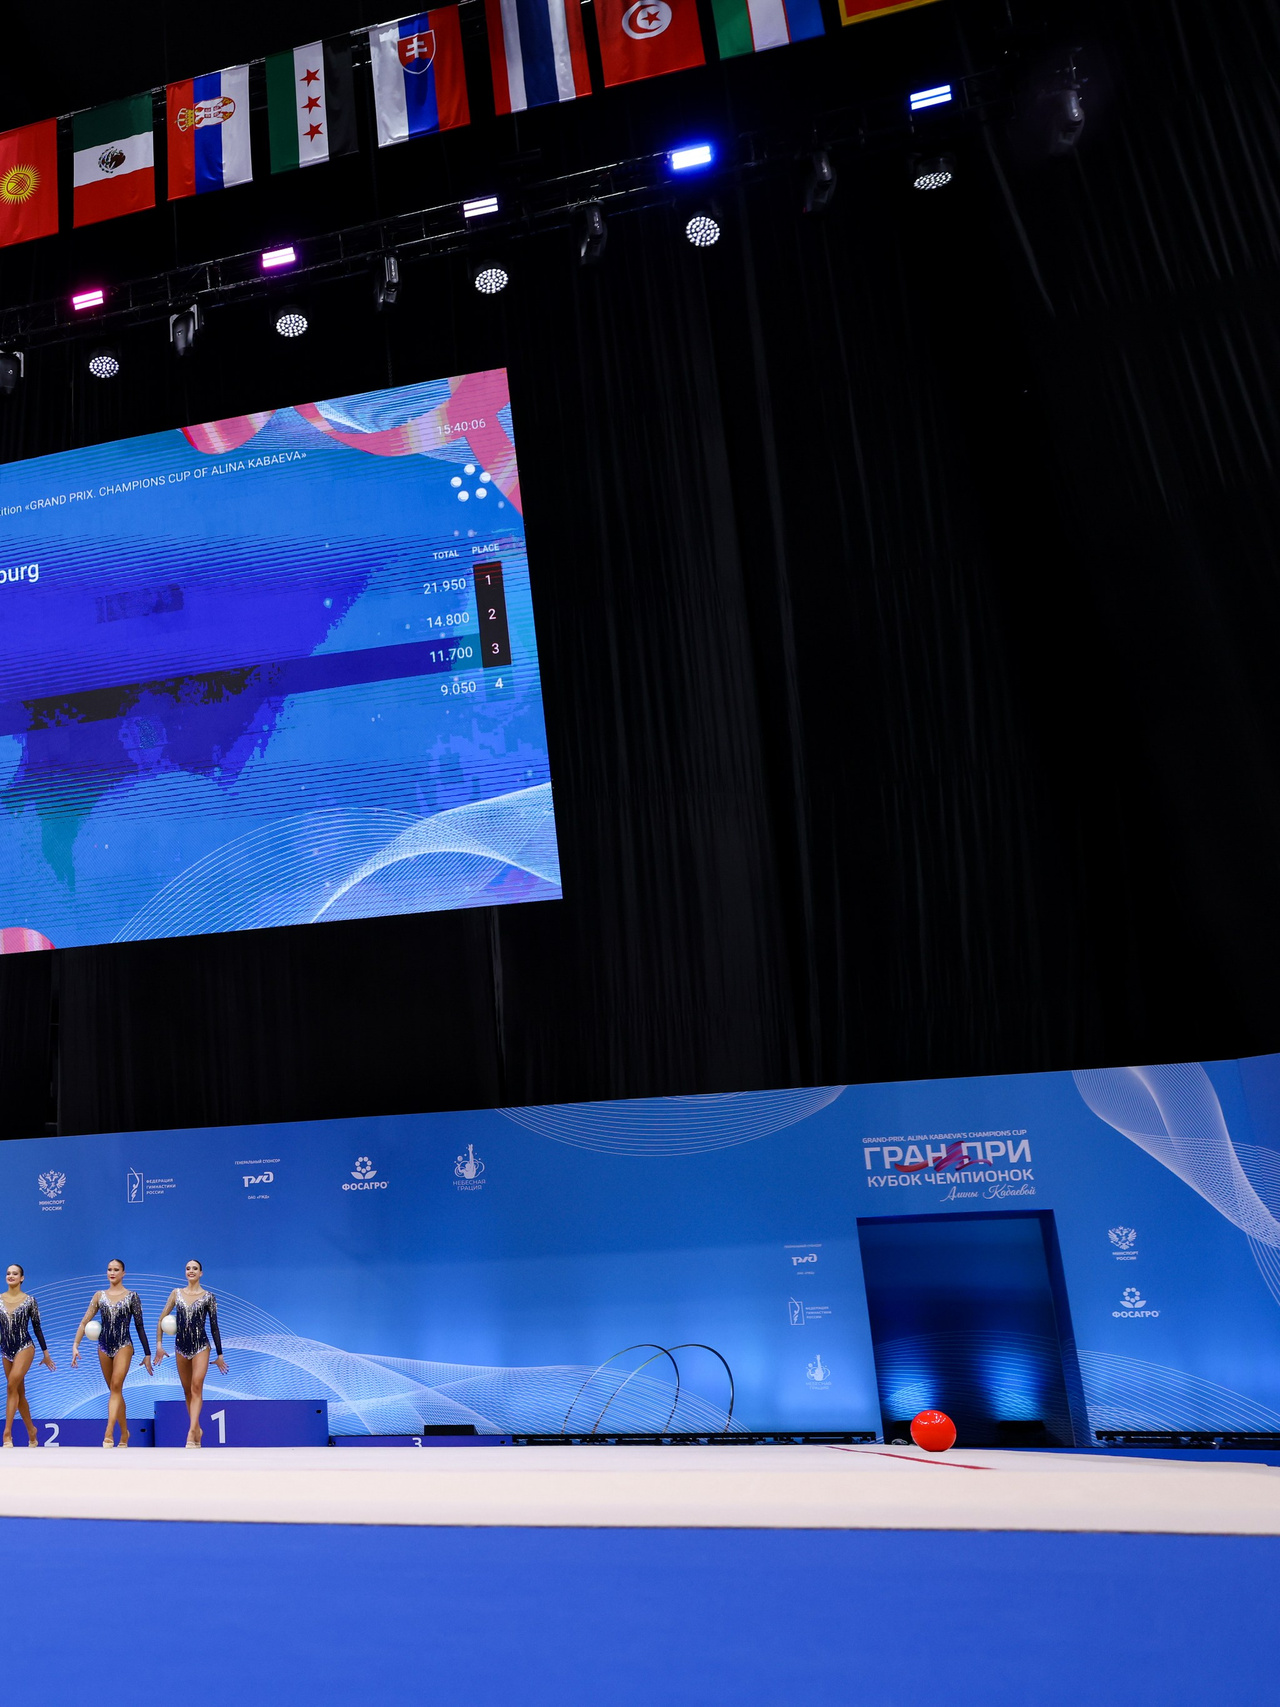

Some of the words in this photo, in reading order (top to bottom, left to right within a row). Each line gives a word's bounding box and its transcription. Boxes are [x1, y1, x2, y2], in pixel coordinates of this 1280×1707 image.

[437, 418, 486, 435] 15:40:06
[25, 494, 67, 511] «GRAND
[69, 489, 96, 503] PRIX.
[99, 475, 166, 497] CHAMPIONS
[168, 470, 191, 484] CUP
[194, 467, 209, 479] OF
[211, 460, 245, 476] ALINA
[248, 450, 307, 469] KABAEVA»
[433, 550, 460, 560] TOTAL
[472, 543, 500, 554] PLACE
[423, 578, 466, 595] 21.950
[485, 574, 492, 585] 1
[426, 612, 470, 628] 14.800
[488, 608, 497, 620] 2
[429, 646, 473, 662] 11.700
[491, 642, 500, 654] 3
[440, 681, 477, 696] 9.050
[495, 677, 504, 689] 4
[908, 1134, 928, 1142] ALINA
[968, 1130, 1011, 1138] CHAMPIONS
[863, 1143, 946, 1170] ГРАН
[961, 1139, 1032, 1165] ПРИ
[867, 1174, 922, 1188] КУБОК
[924, 1168, 1035, 1185] ЧЕМПИОНОК
[342, 1181, 388, 1191] ФОСАГРО
[940, 1186, 979, 1202] Алины
[982, 1183, 1037, 1200] Кабаевой
[1111, 1310, 1160, 1318] ФОСАГРО
[210, 1409, 226, 1443] 1
[44, 1423, 60, 1447] 2
[412, 1437, 422, 1447] 3
